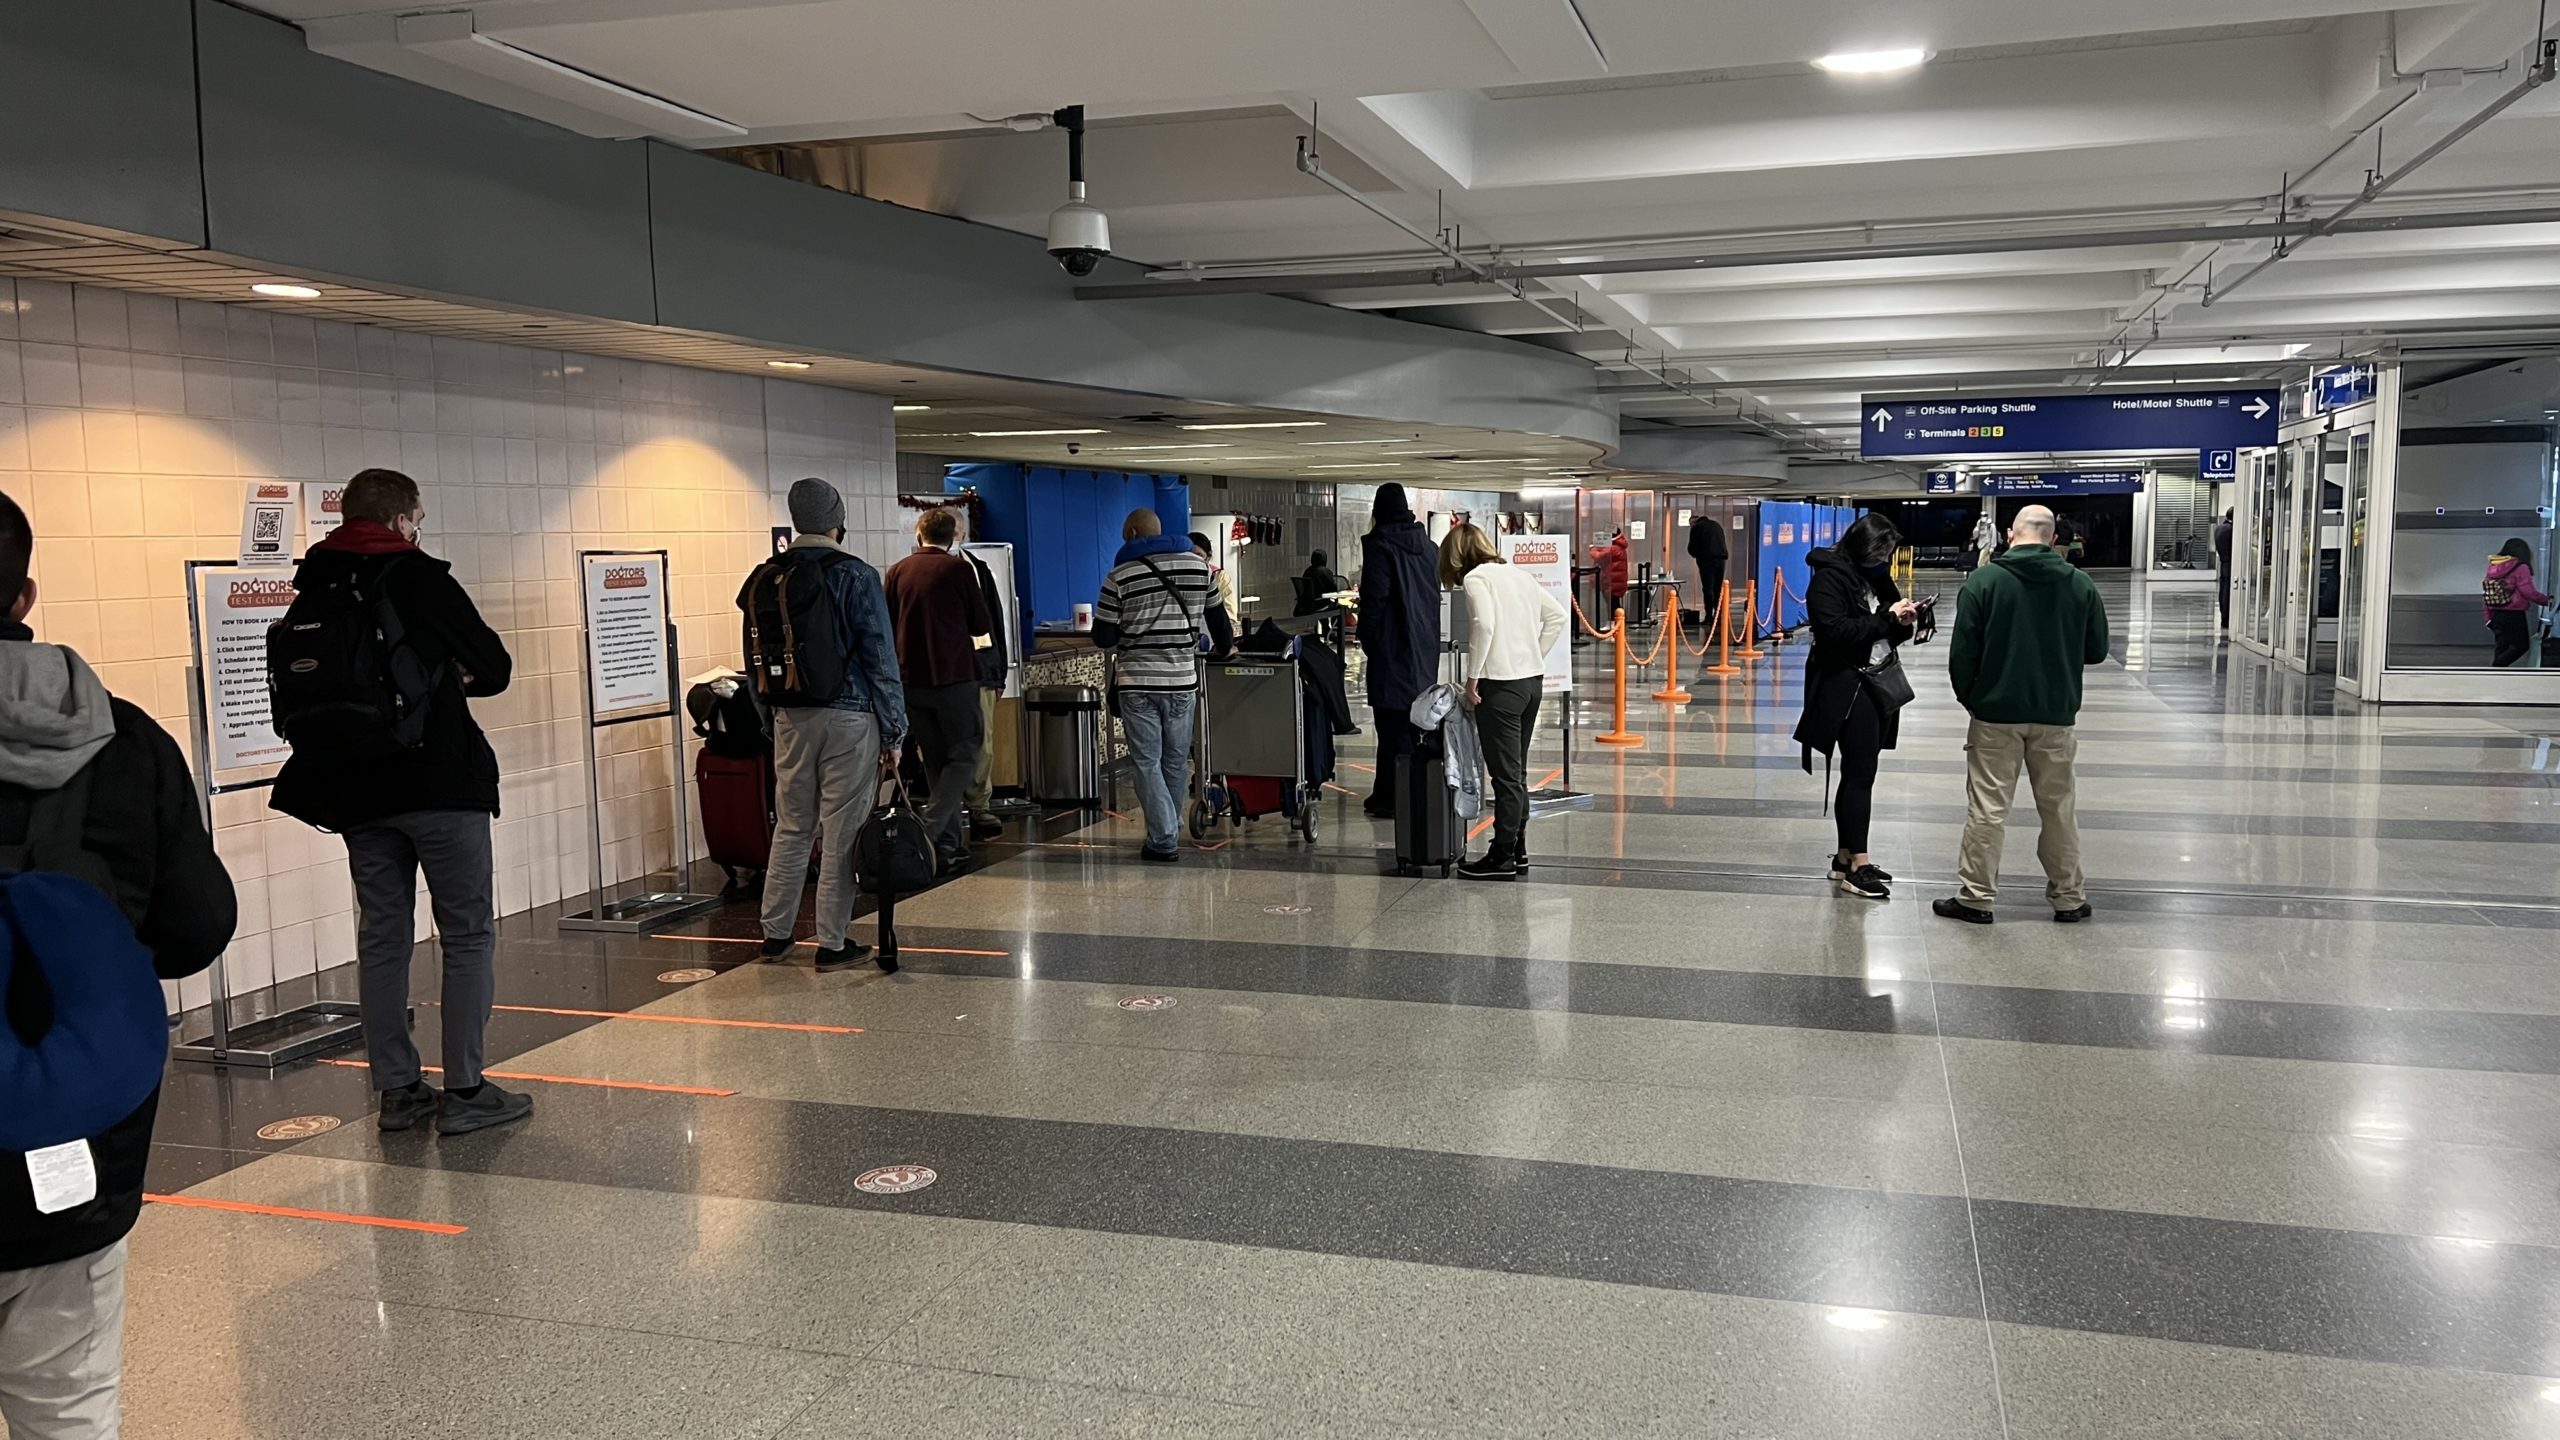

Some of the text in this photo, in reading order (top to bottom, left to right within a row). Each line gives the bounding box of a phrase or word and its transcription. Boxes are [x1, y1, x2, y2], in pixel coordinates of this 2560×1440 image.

[1920, 403, 2037, 415] Off-Site Parking Shuttle
[2113, 398, 2213, 409] Hotel/Motel Shuttle
[1920, 429, 1966, 438] Terminals
[1515, 540, 1557, 553] DOCTORS
[605, 566, 645, 578] DOCTORS
[230, 577, 294, 594] DOCTORS
[231, 596, 296, 605] TEST CENTERS
[229, 720, 254, 728] Approach
